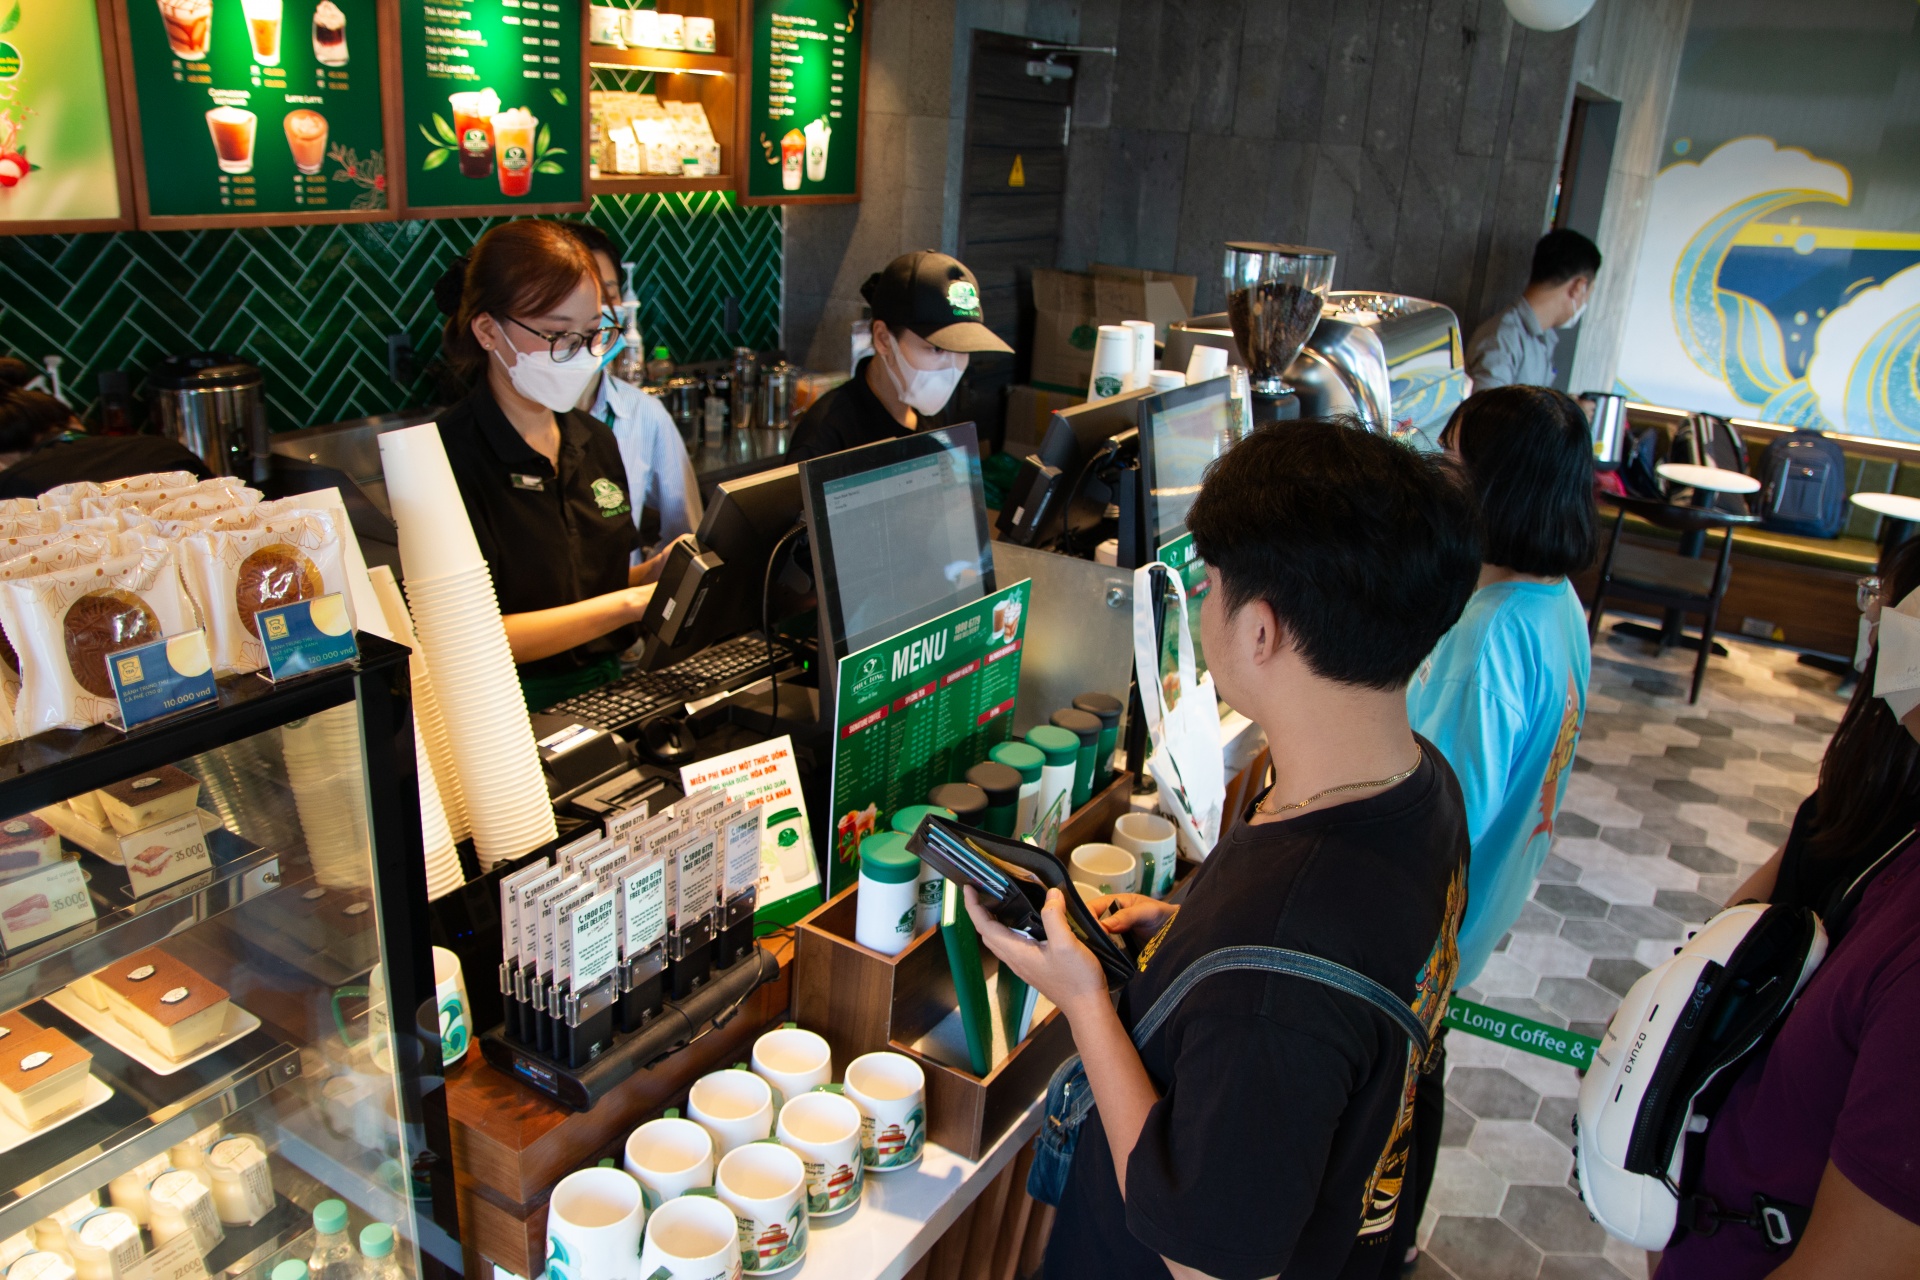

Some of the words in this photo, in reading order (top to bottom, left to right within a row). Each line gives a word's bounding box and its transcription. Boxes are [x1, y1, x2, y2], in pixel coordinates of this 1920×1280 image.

[308, 650, 338, 664] 120.000
[891, 628, 948, 682] MENU
[163, 692, 195, 709] 110.000
[721, 765, 737, 777] NGAY
[713, 801, 724, 812] 6779
[619, 821, 632, 832] 1800
[632, 814, 645, 825] 6779
[654, 836, 667, 847] 1800
[667, 828, 679, 839] 6779
[174, 842, 204, 862] 35.000
[682, 860, 693, 873] FREE
[694, 850, 714, 866] DELIVERY
[688, 848, 701, 861] 1800
[702, 842, 714, 854] 6779
[600, 862, 613, 874] 1800
[614, 854, 627, 867] 6779
[629, 888, 641, 901] FREE
[641, 876, 662, 894] DELIVERY
[636, 875, 649, 889] 1800
[649, 868, 662, 880] 6779
[52, 891, 86, 911] 35.000
[584, 908, 599, 921] 1800
[599, 899, 613, 913] 6779
[577, 921, 589, 934] FREE
[590, 908, 613, 927] DELIVERY
[1463, 1006, 1506, 1038] Long
[1510, 1022, 1566, 1054] Coffee
[1570, 1041, 1585, 1061] &
[1624, 1032, 1647, 1074] OZUKO
